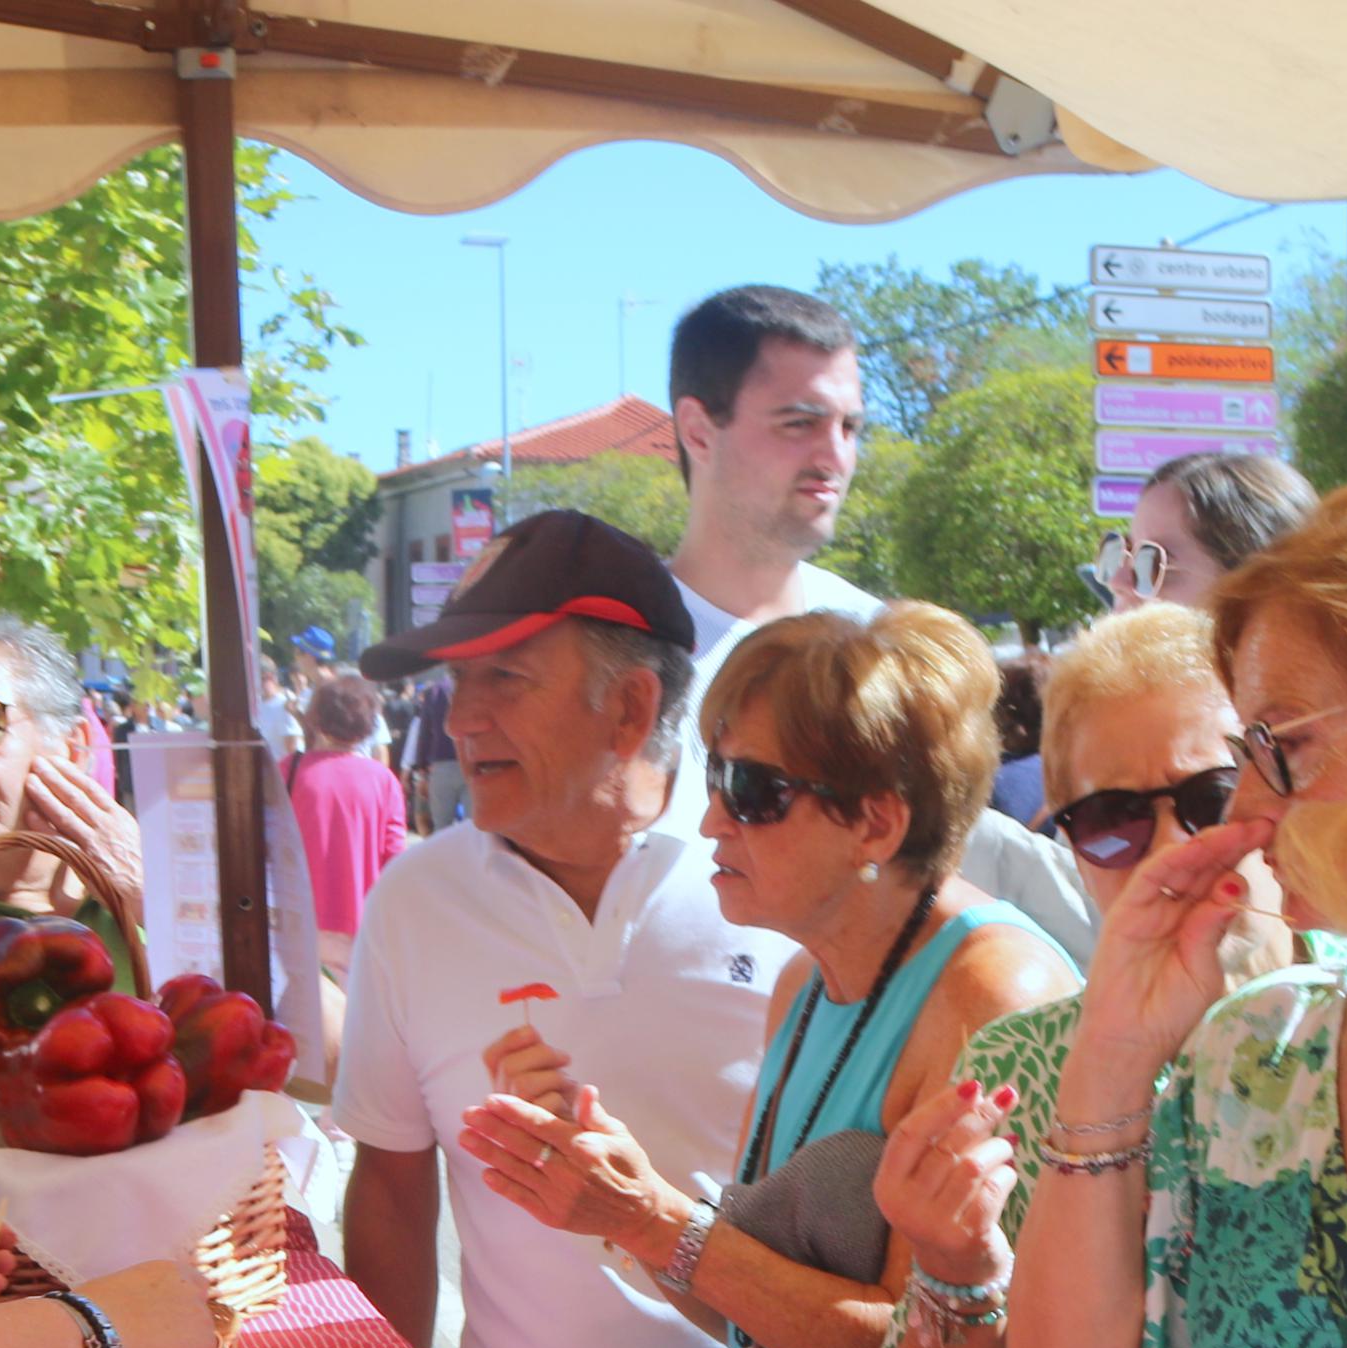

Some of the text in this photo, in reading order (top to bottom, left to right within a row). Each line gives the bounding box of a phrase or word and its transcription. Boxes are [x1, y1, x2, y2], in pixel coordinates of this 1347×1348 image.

[1157, 260, 1264, 280] centro urbano
[1202, 307, 1264, 328] bodegas
[1168, 354, 1268, 370] polideportivo
